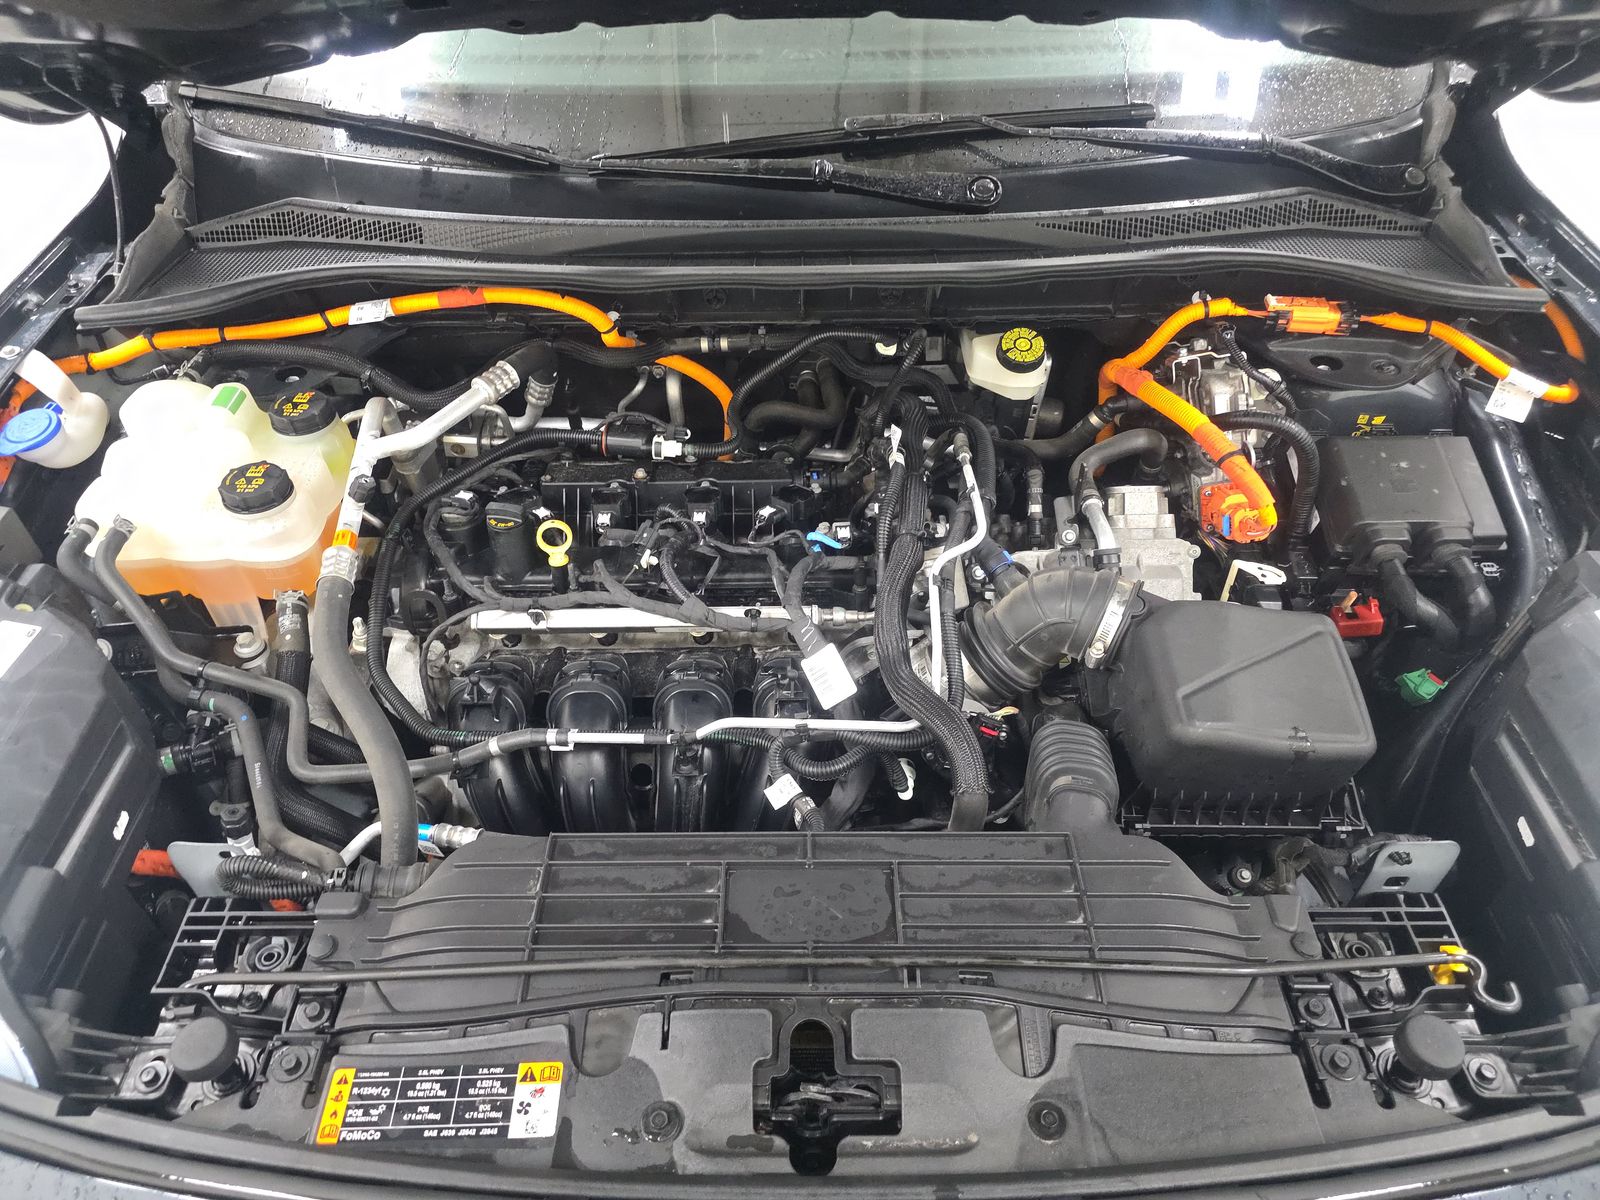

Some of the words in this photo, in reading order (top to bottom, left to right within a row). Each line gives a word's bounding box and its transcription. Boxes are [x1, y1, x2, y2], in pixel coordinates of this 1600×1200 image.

[352, 1086, 382, 1096] R-1234yf
[346, 1109, 364, 1117] POE
[340, 1130, 380, 1140] FoMoCo
